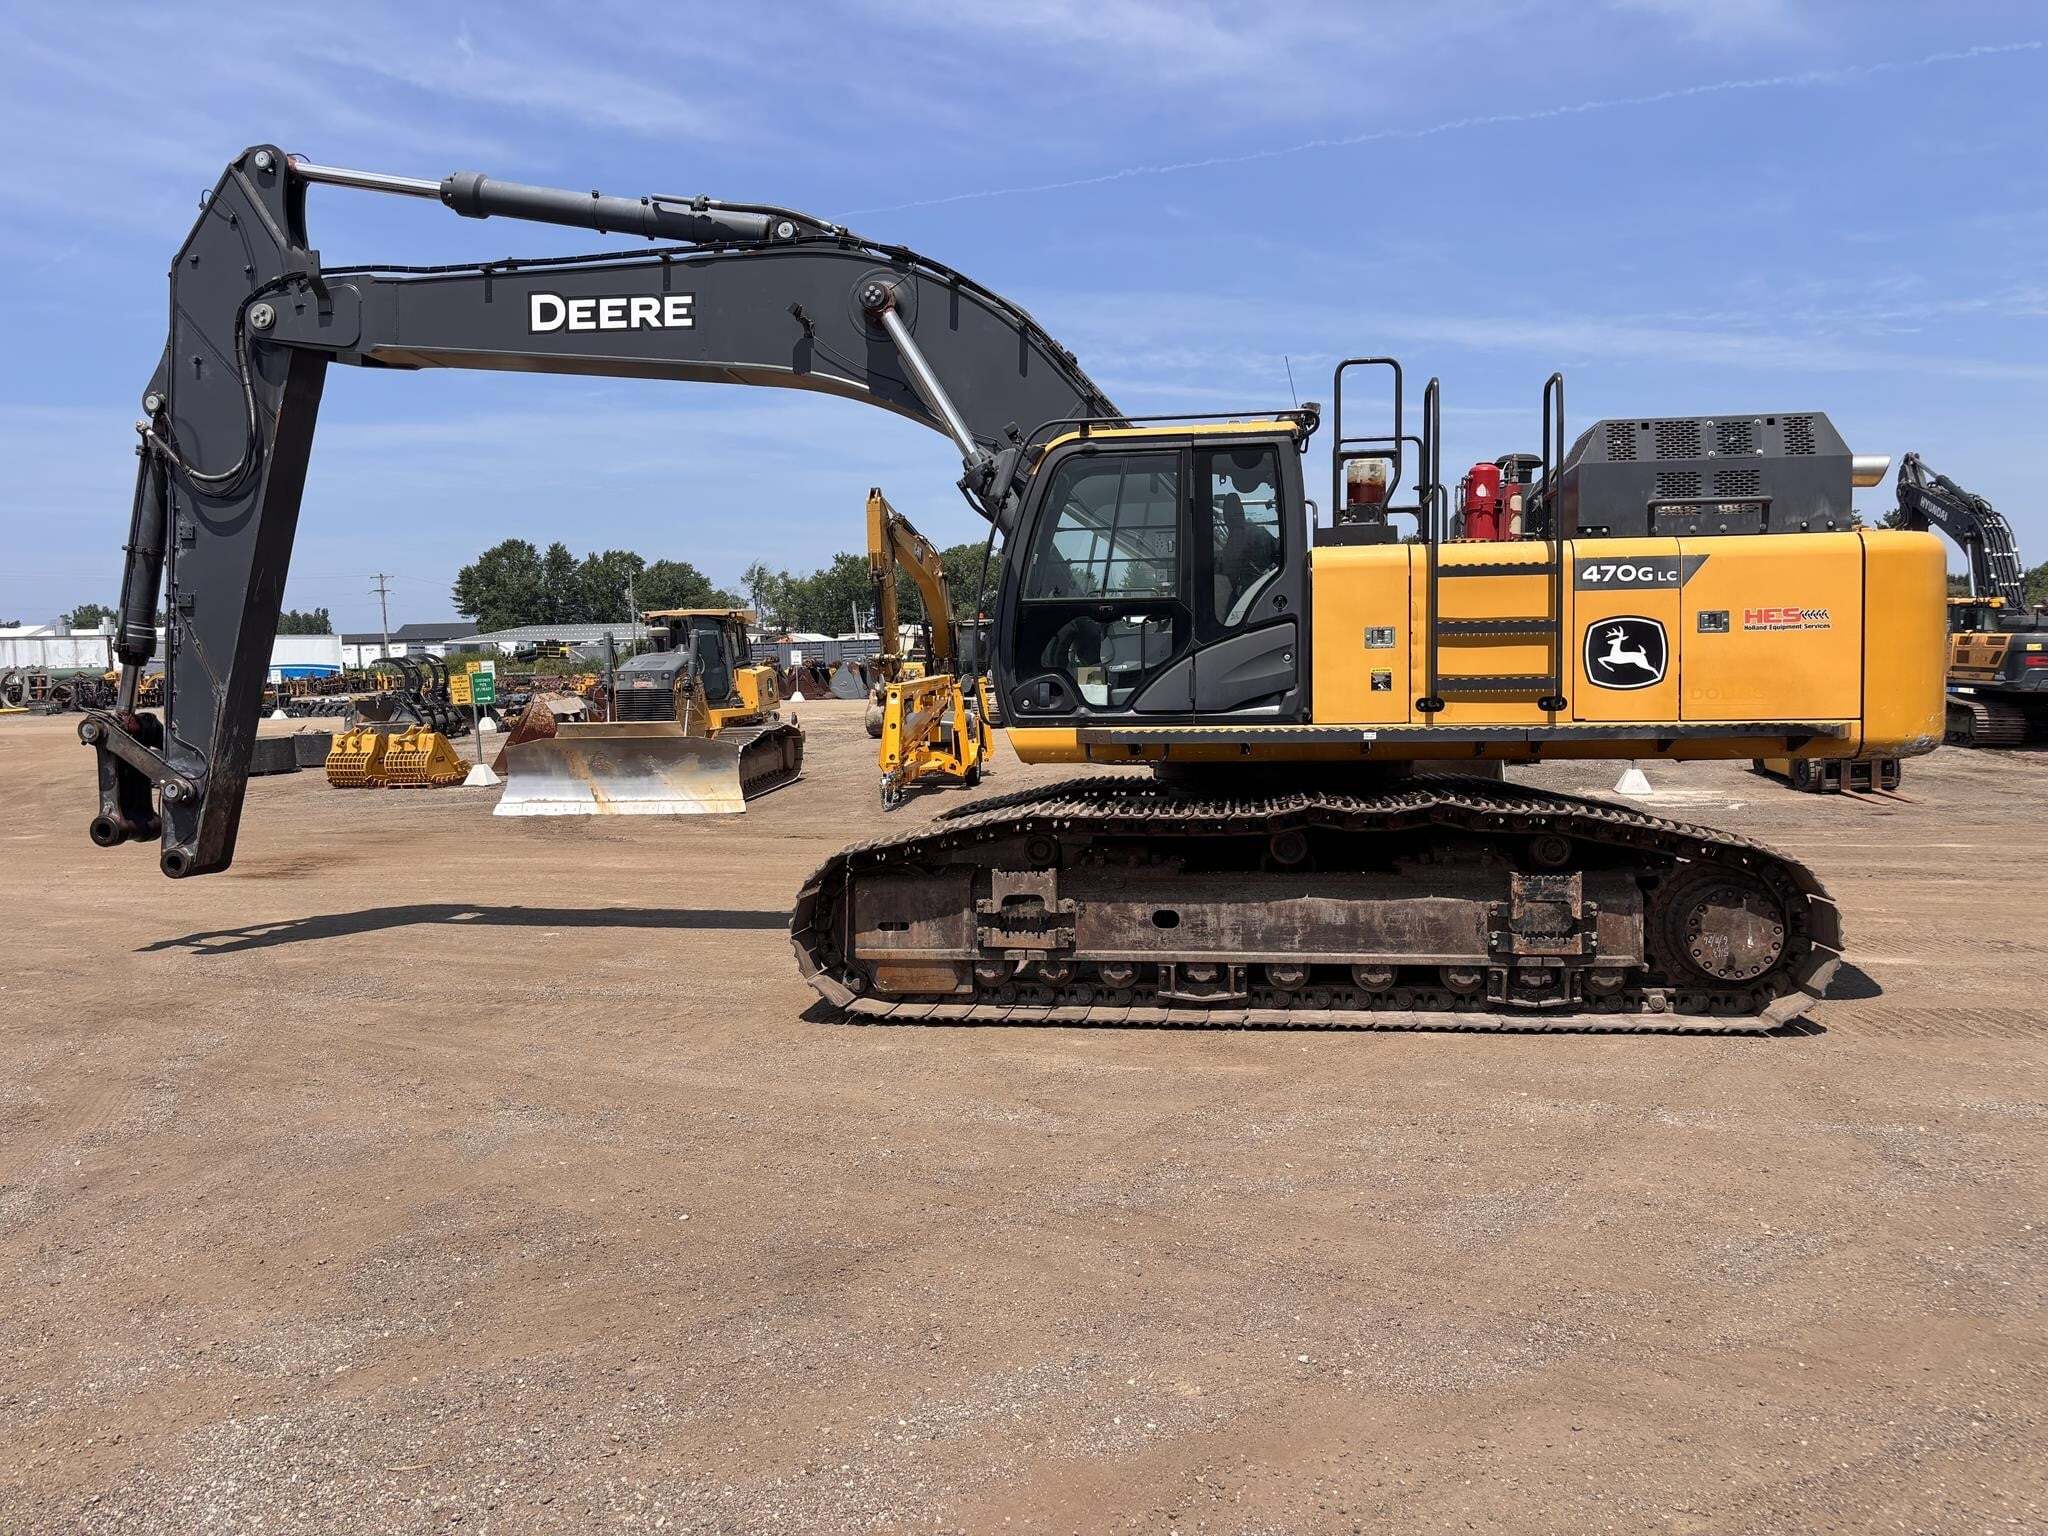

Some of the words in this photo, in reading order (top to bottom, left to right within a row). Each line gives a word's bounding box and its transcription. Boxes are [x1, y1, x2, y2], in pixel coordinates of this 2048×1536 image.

[531, 294, 692, 331] DEERE
[1920, 496, 1948, 521] HYUNDAI
[1582, 564, 1653, 582] 470G
[1657, 571, 1678, 581] LC
[1744, 608, 1802, 624] HES
